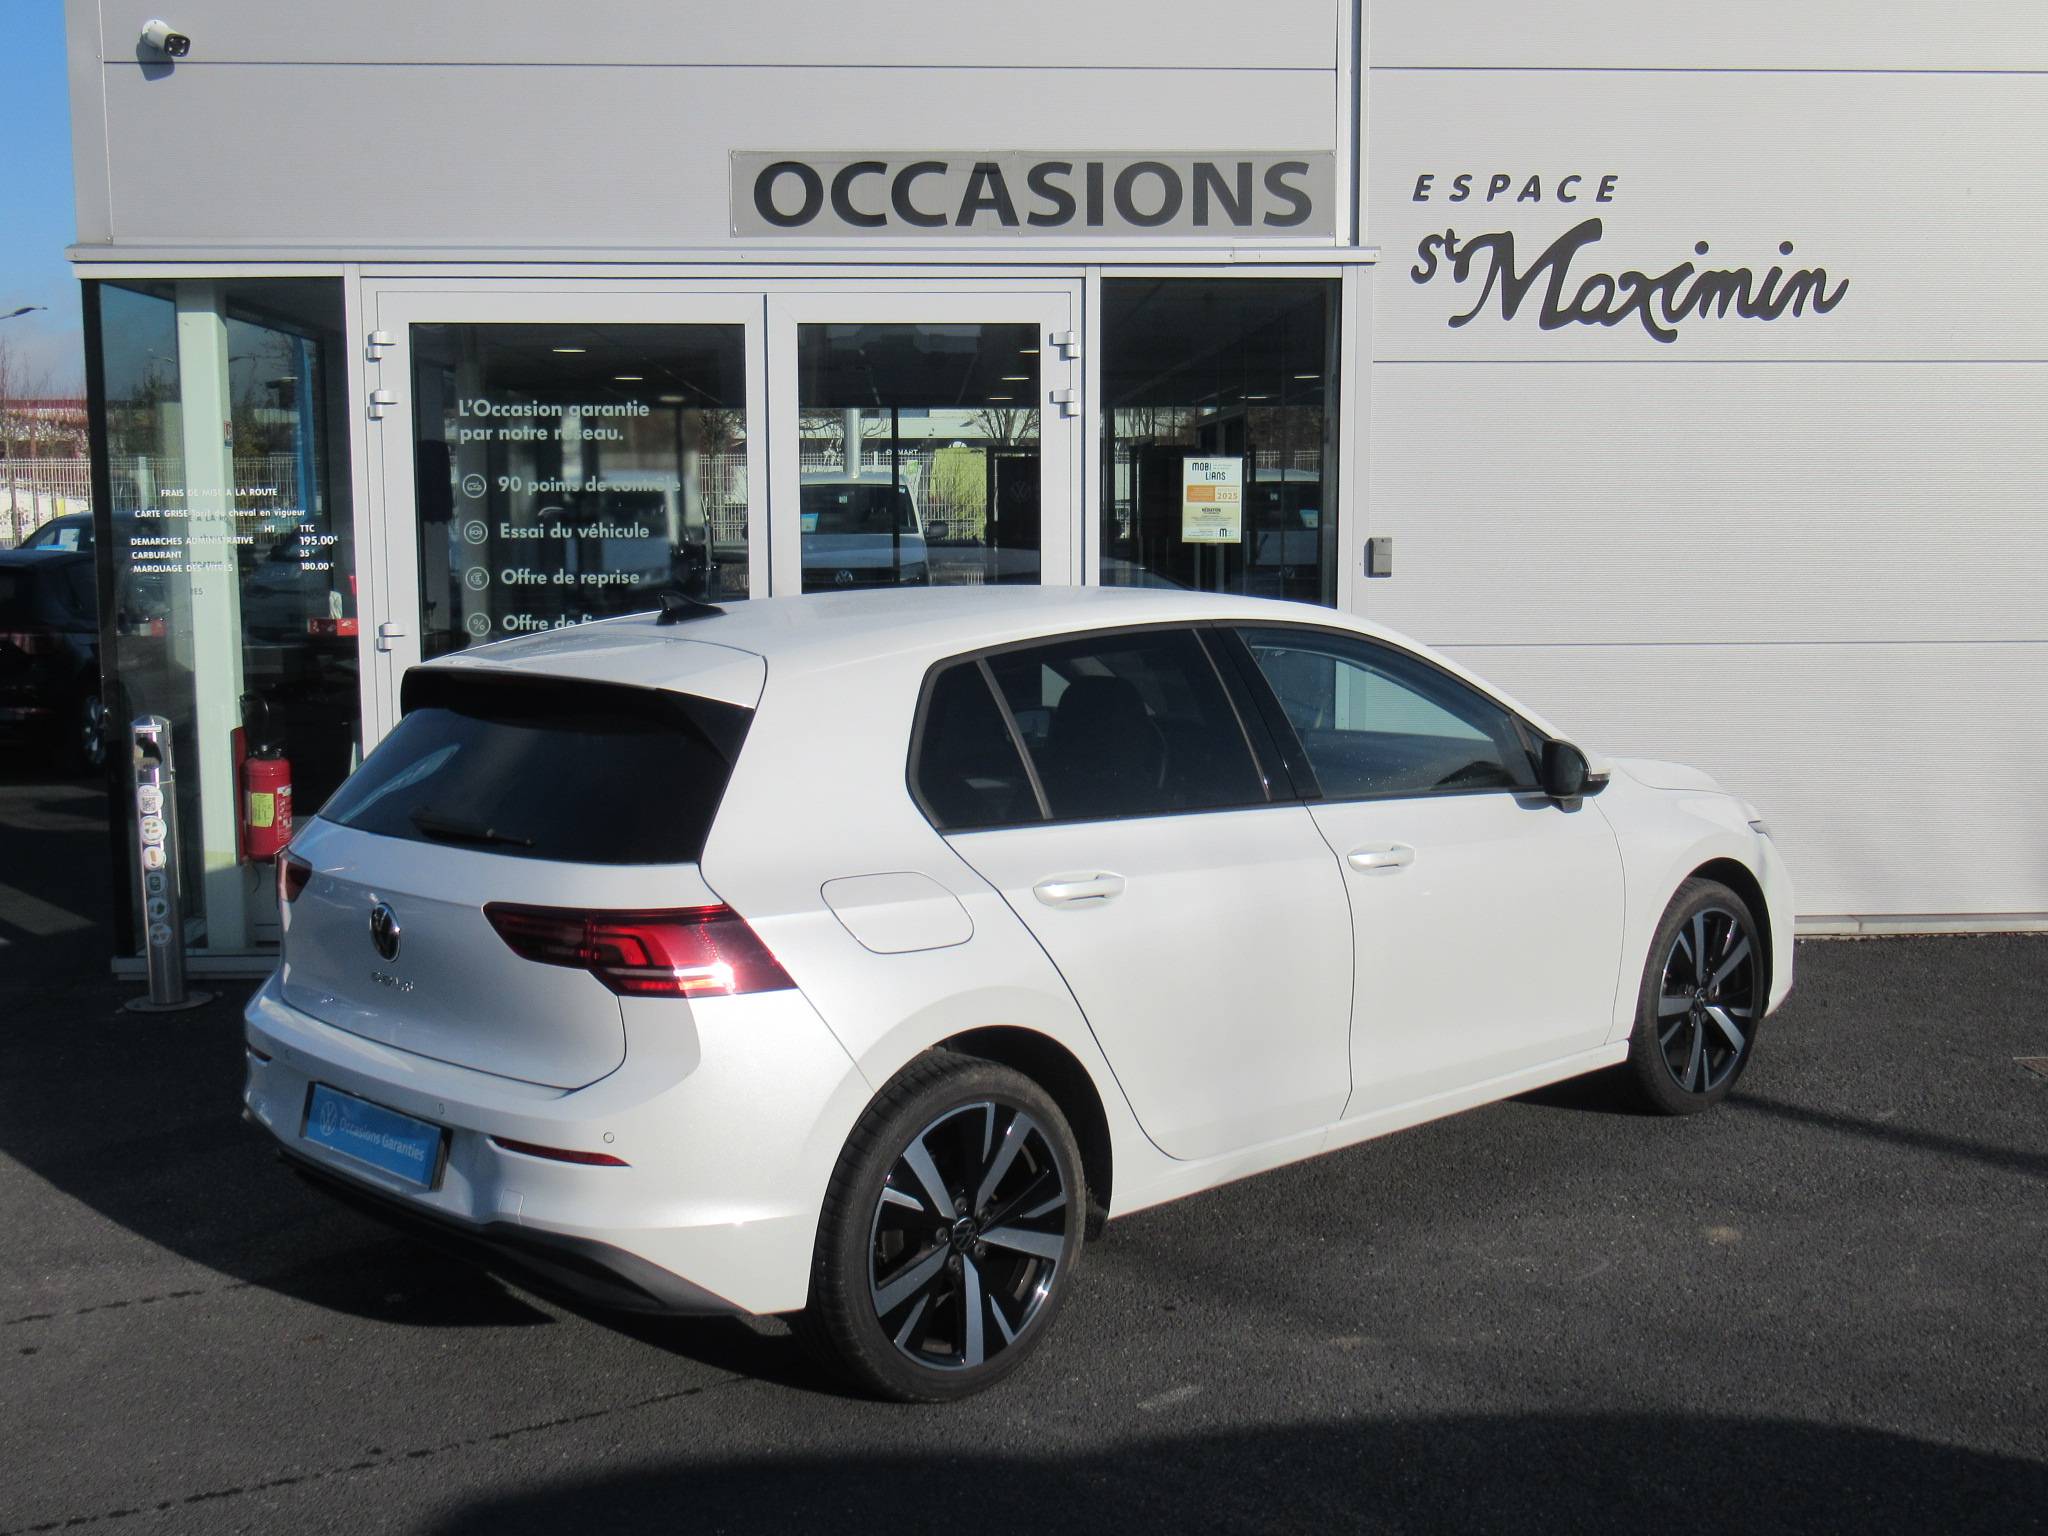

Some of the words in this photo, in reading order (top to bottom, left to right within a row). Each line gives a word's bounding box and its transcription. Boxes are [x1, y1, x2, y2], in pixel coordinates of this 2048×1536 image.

[752, 161, 1313, 228] OCCASIONS
[1412, 174, 1619, 203] ESPACE
[1447, 217, 1850, 344] Maximin
[568, 400, 650, 421] garantie
[460, 426, 493, 444] par
[499, 424, 548, 441] notre
[554, 424, 624, 441] rseau.
[160, 489, 185, 497] FRAIS
[235, 488, 246, 497] LA
[249, 488, 278, 496] ROUTE
[498, 476, 522, 492] 90
[528, 477, 580, 496] points
[585, 475, 608, 492] de
[134, 509, 161, 518] CARTE
[164, 509, 189, 518] GRISE
[228, 508, 257, 517] cheval
[259, 509, 271, 517] en
[274, 508, 305, 519] vigueur
[264, 525, 275, 533] HT
[300, 524, 315, 533] TTC
[500, 522, 544, 539] Essai
[550, 522, 573, 539] du
[578, 522, 650, 539] véhicule
[130, 537, 183, 546] DEMARCHES
[131, 551, 183, 560] CARBURANT
[132, 564, 183, 573] MARQUAGE
[501, 568, 548, 585] Offre
[553, 568, 575, 585] de
[580, 569, 640, 588] reprise
[502, 614, 549, 631] Offre
[555, 614, 576, 629] de
[339, 1118, 381, 1145] Occasions
[382, 1134, 425, 1162] Garanties
